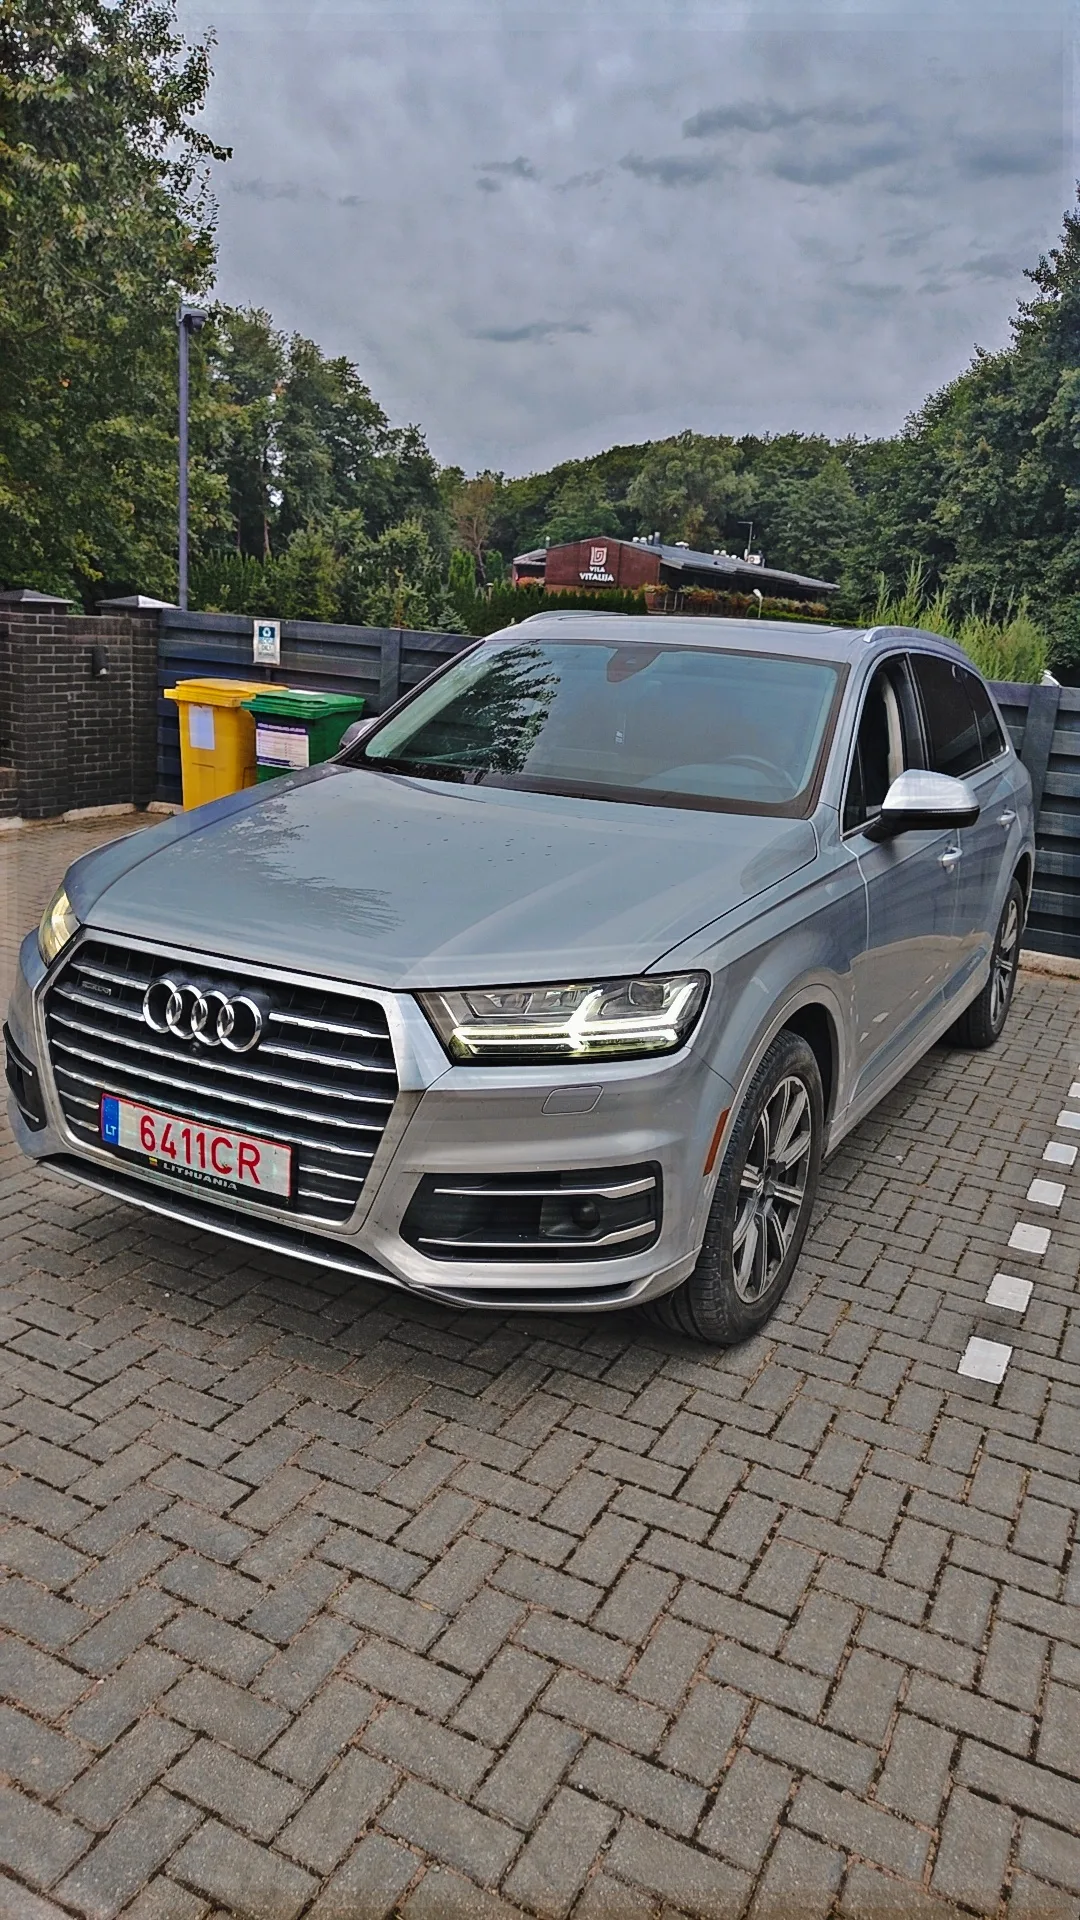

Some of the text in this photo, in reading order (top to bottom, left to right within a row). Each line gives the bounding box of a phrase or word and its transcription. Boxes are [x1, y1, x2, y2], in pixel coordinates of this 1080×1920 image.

[579, 572, 614, 582] VITALIJA
[105, 1124, 117, 1136] LT
[140, 1115, 261, 1185] 6411CR
[163, 1162, 238, 1190] LITHUANIA
